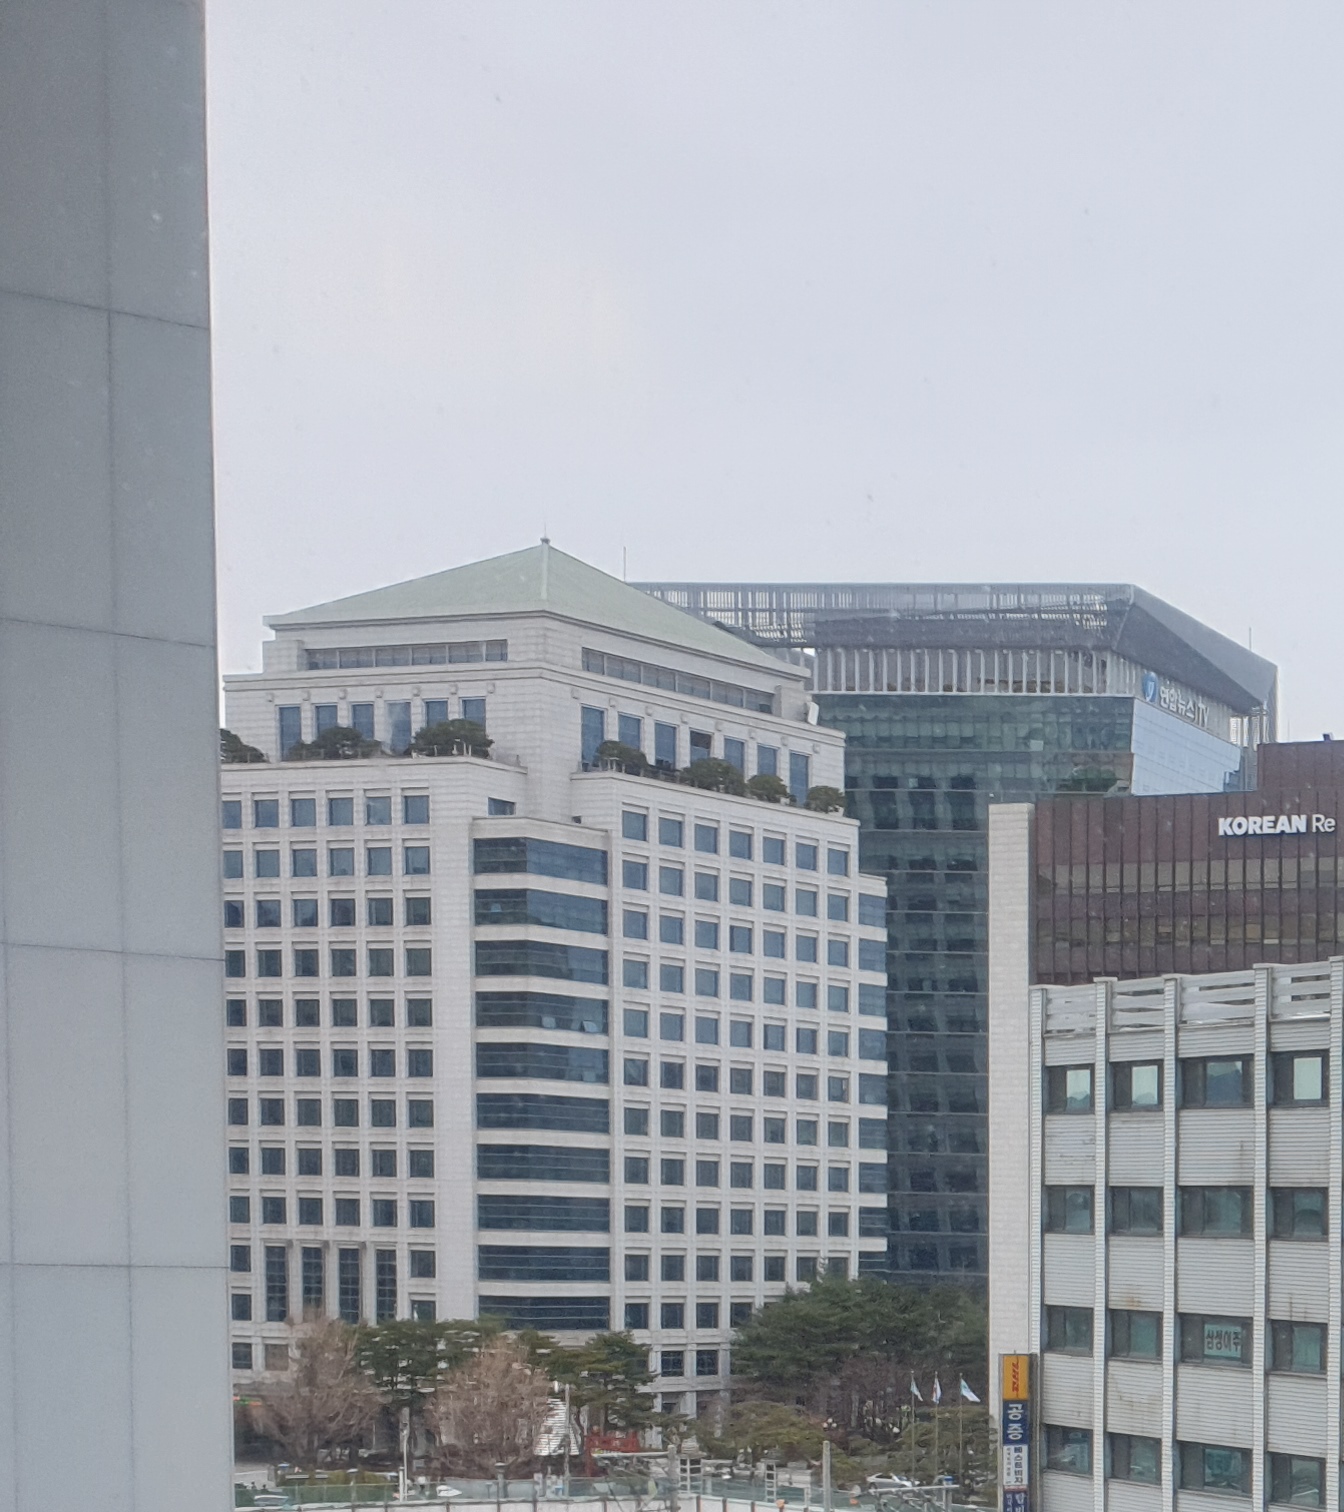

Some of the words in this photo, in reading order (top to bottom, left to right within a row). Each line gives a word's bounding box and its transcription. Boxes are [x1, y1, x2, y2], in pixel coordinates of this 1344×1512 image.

[1218, 814, 1307, 836] KOREAN
[1312, 814, 1336, 833] Re
[1205, 1328, 1242, 1352] 삼성이주
[1006, 1403, 1024, 1440] 공증
